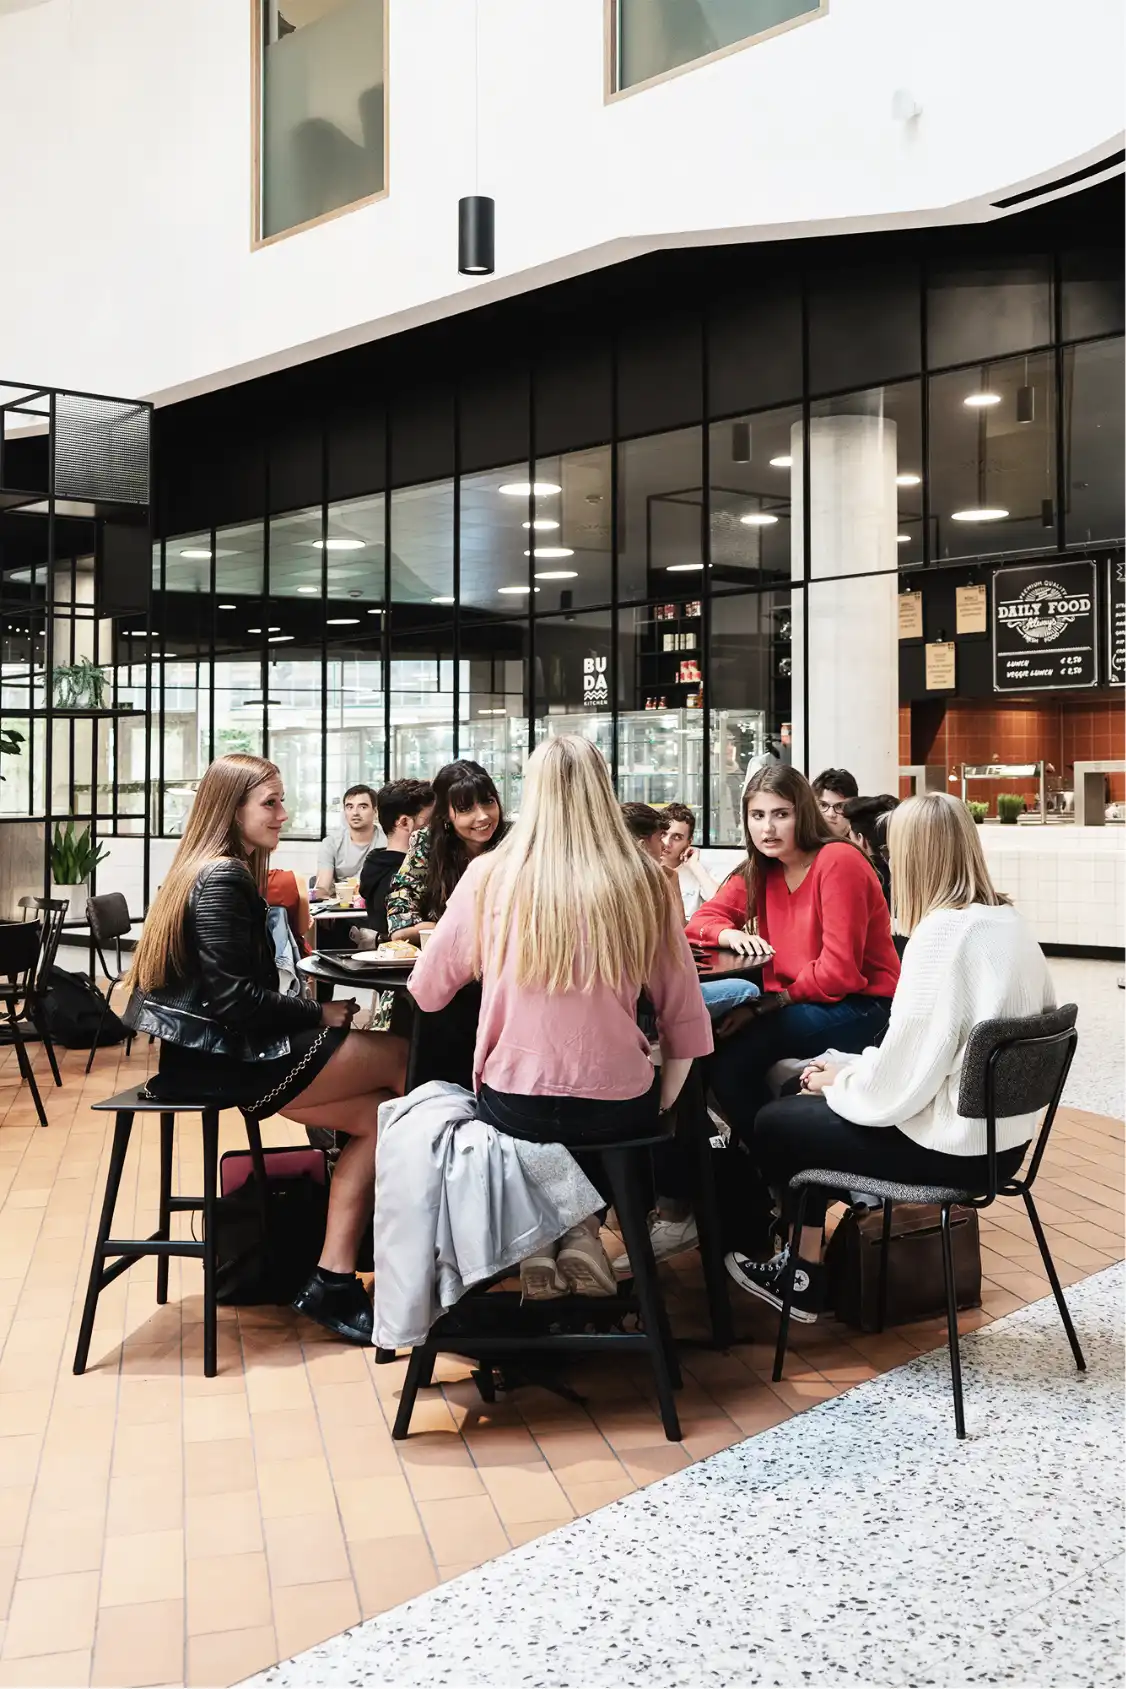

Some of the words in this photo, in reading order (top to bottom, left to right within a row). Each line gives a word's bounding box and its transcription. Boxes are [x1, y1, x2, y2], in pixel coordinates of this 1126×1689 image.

[1019, 580, 1042, 599] PREMIUM
[1044, 580, 1067, 595] QUALITY
[998, 604, 1042, 618] DAILY
[1048, 600, 1090, 614] FOOD
[1022, 616, 1057, 631] Always
[1044, 632, 1060, 643] FOOD
[584, 656, 606, 674] BU
[584, 674, 608, 690] DA
